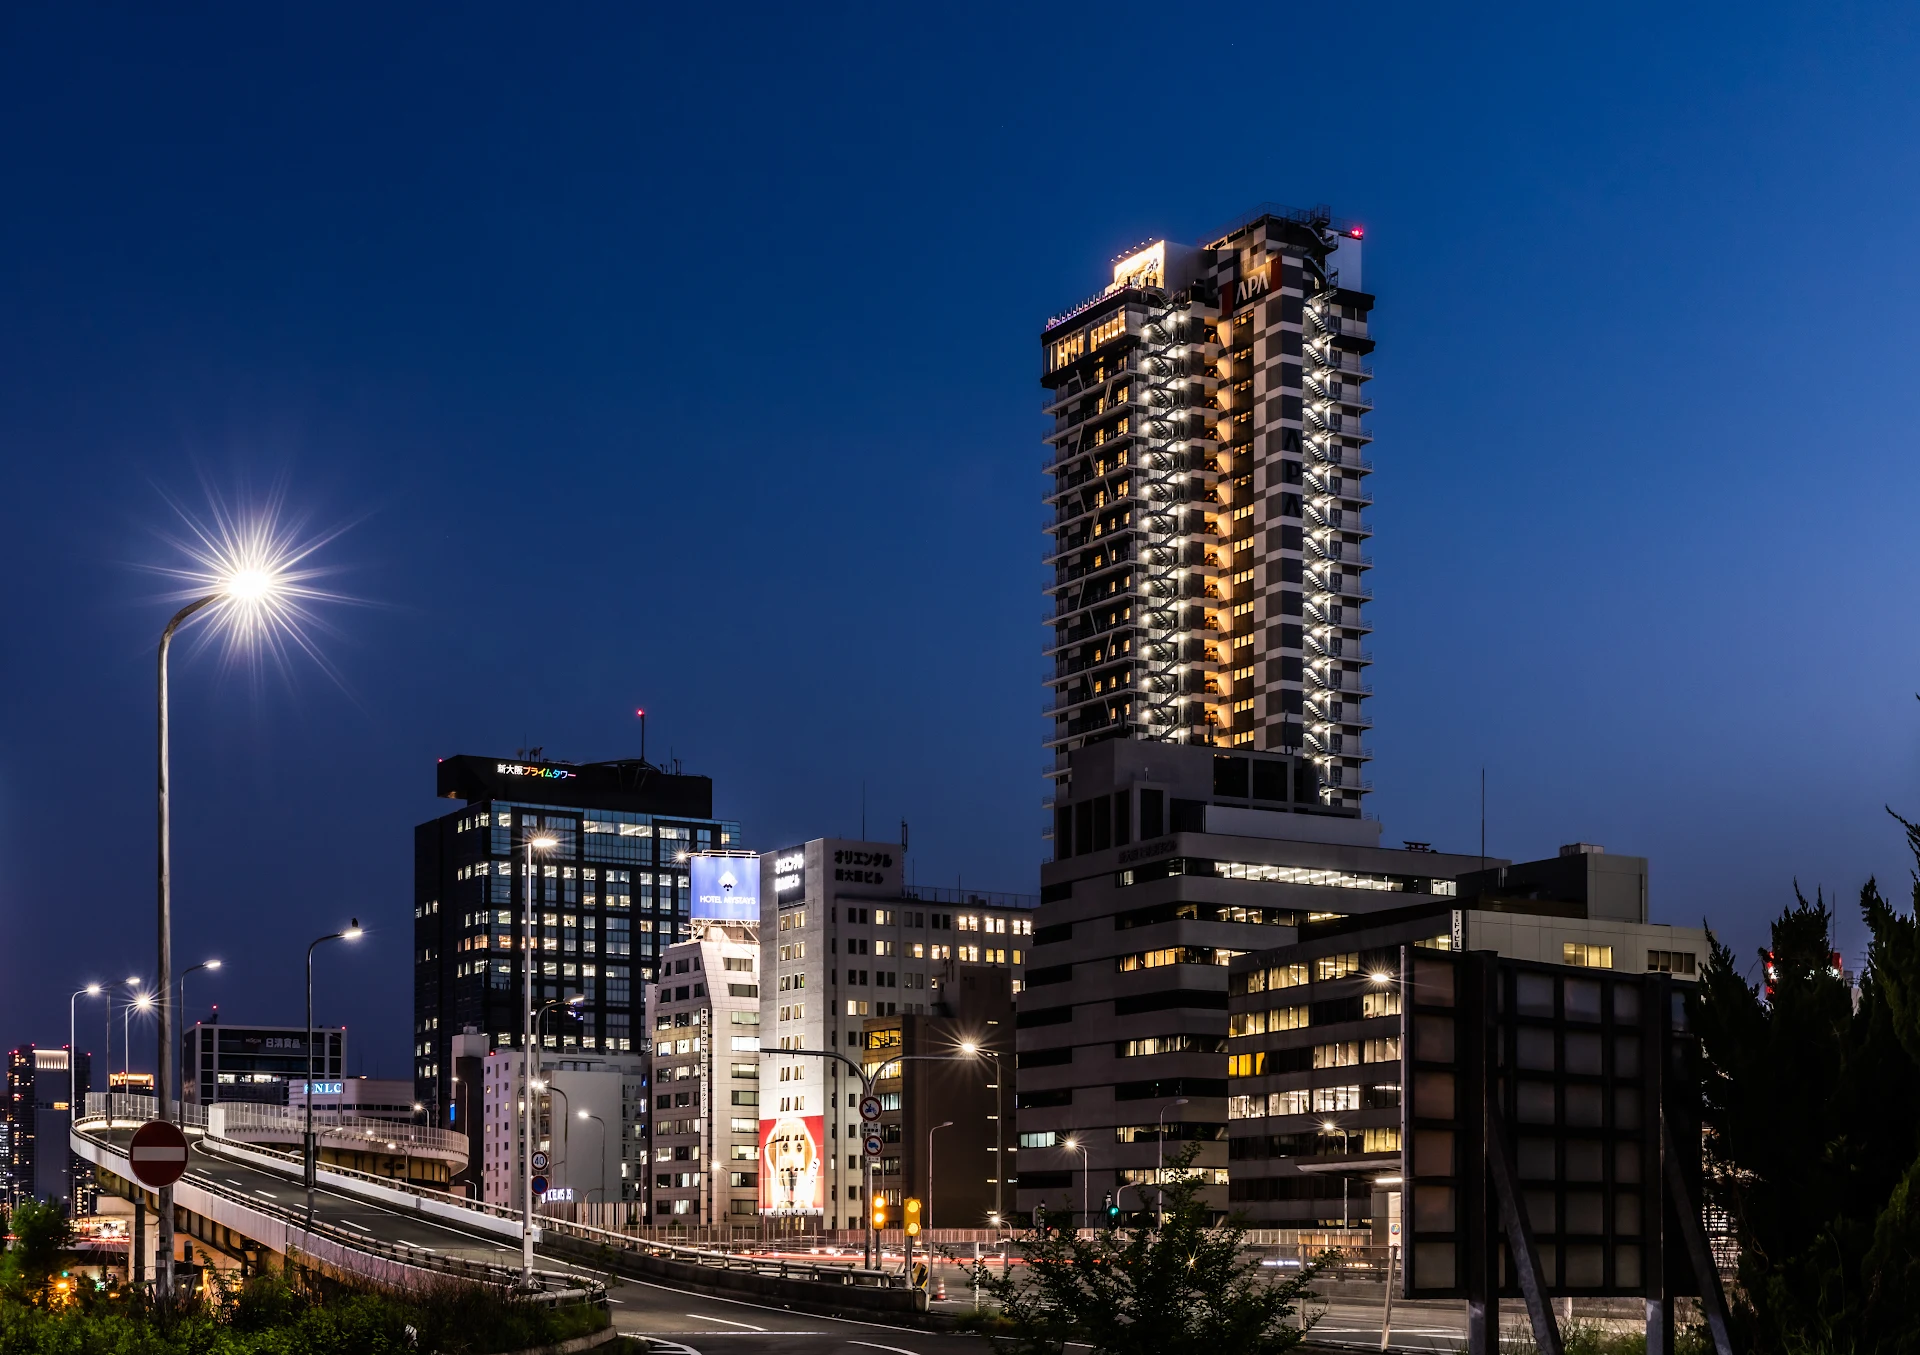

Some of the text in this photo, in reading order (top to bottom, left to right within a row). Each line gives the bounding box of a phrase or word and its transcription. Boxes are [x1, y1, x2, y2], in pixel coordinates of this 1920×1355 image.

[1235, 270, 1269, 304] APA
[1283, 428, 1301, 518] APA
[497, 763, 576, 779] 新大阪プライムタワー
[834, 849, 893, 868] オリエンタル
[835, 868, 884, 884] 新大阪ビル
[699, 895, 756, 905] HOTEL MYSTAYS
[265, 1037, 301, 1049] 日清食品
[314, 1083, 342, 1093] NLC
[534, 1156, 545, 1165] 40
